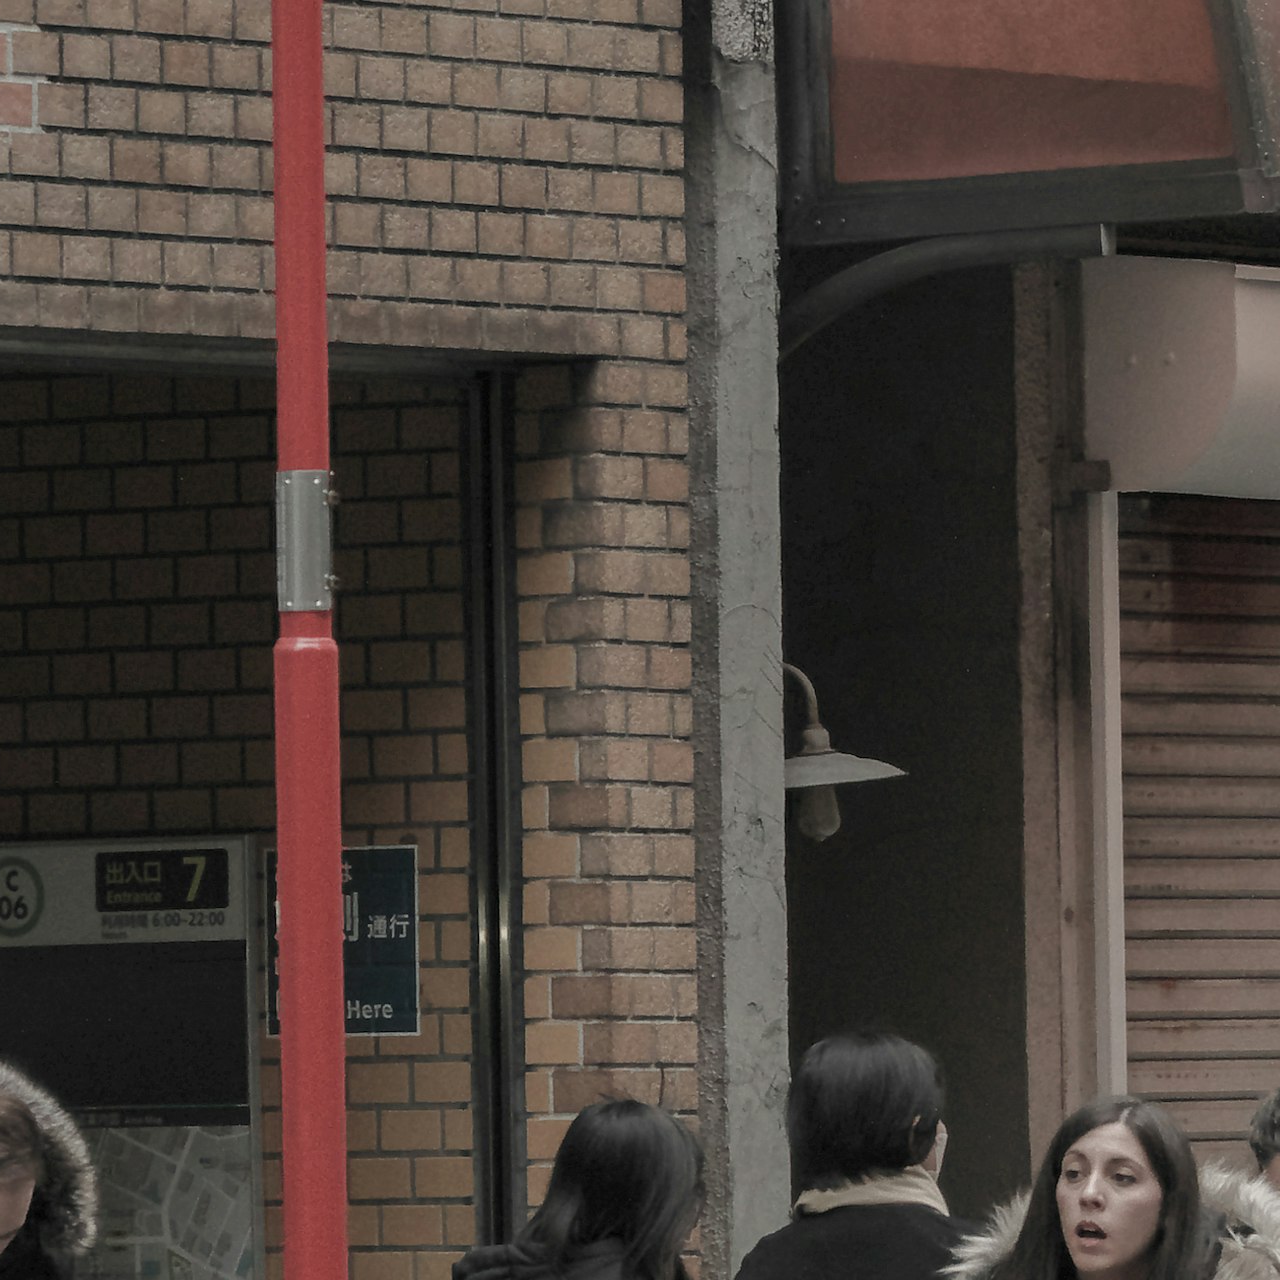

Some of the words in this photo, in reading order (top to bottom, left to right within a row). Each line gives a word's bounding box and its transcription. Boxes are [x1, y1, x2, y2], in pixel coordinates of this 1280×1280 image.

[6, 869, 19, 892] C
[105, 861, 161, 884] 出入口
[182, 856, 206, 902] 7
[347, 999, 394, 1019] Here
